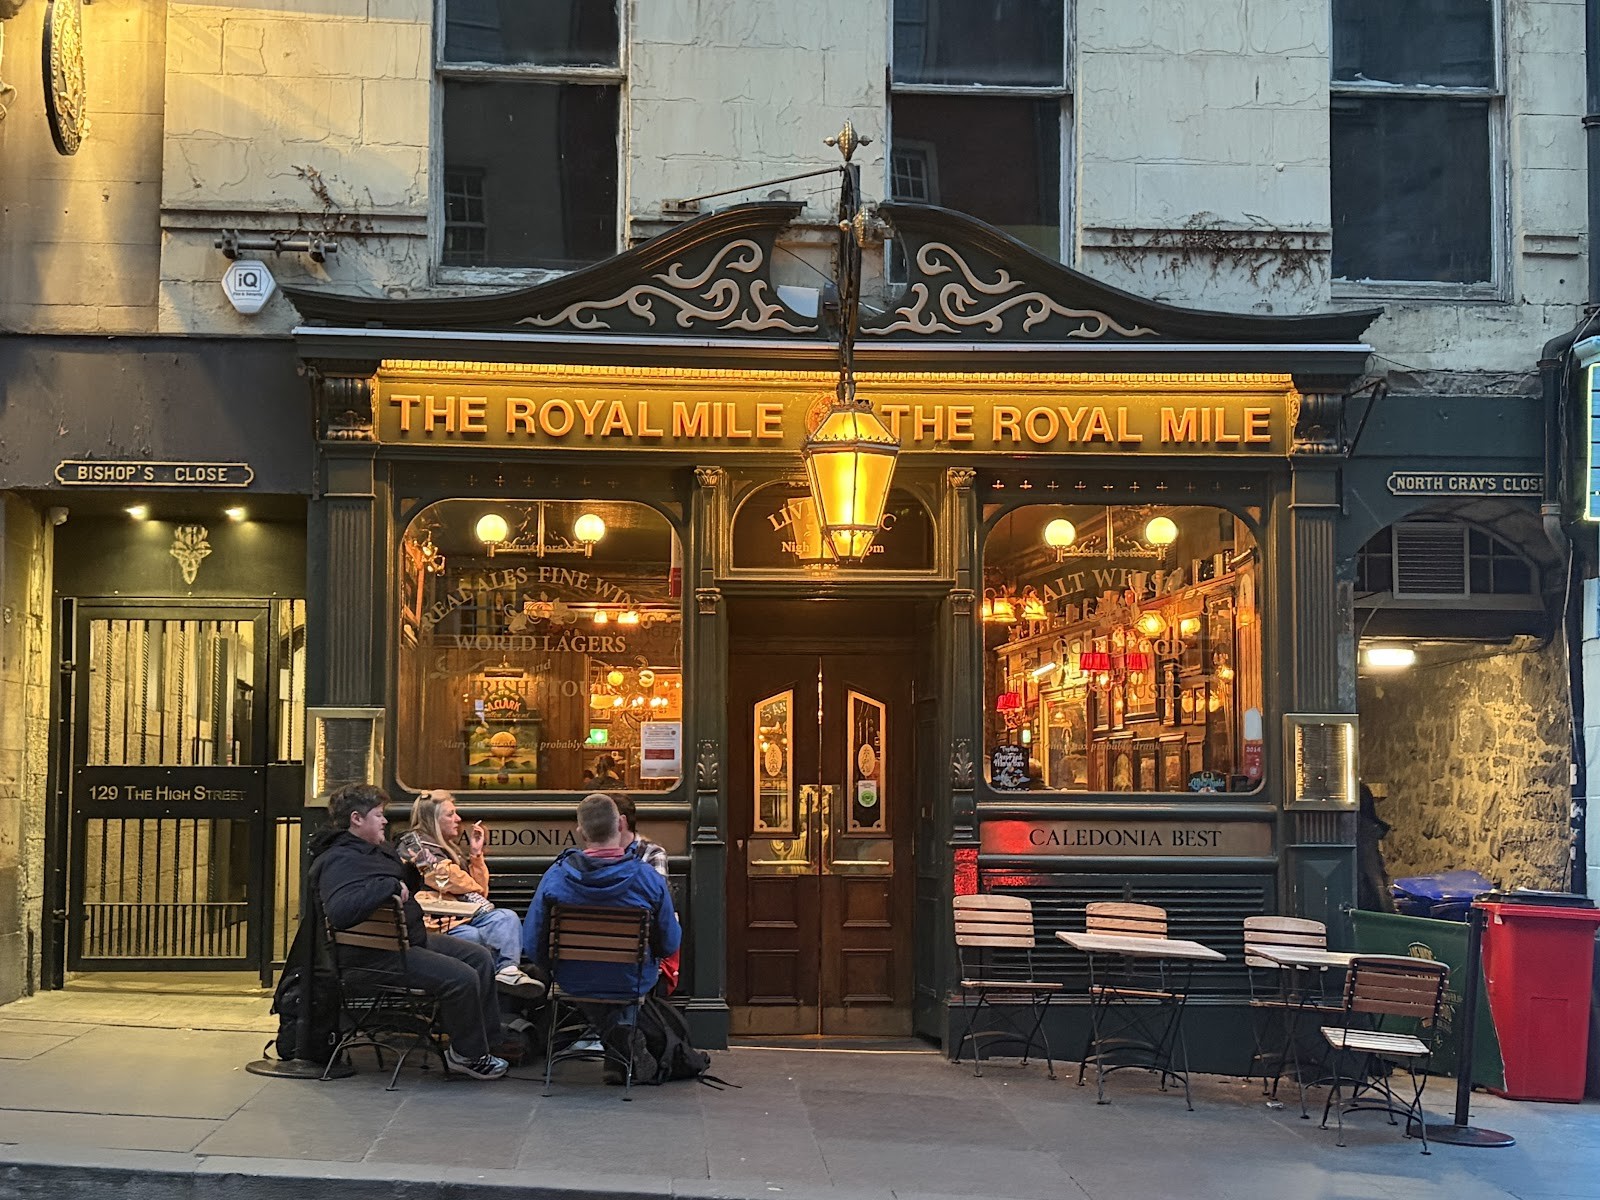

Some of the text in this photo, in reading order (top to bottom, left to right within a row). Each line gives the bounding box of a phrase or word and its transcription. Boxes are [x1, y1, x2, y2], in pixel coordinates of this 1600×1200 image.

[238, 272, 258, 288] iQ
[390, 394, 784, 438] THE ROYAL MILE
[881, 404, 1272, 444] THE ROYAL MILE
[77, 465, 228, 482] BISHOP'S CLOSE
[1396, 476, 1443, 490] NORTH
[1043, 572, 1085, 604] ALT
[421, 566, 656, 632] REAL ALES FINE WINS
[454, 635, 627, 653] WORLD LAGERS
[529, 659, 551, 674] and
[470, 680, 530, 697] IRISH
[540, 740, 581, 752] probably
[1133, 738, 1160, 751] drank
[89, 785, 247, 801] 129 THE HIGH STREET
[458, 829, 577, 846] AEDONIA
[1029, 829, 1222, 847] CALEDONIA BEST
